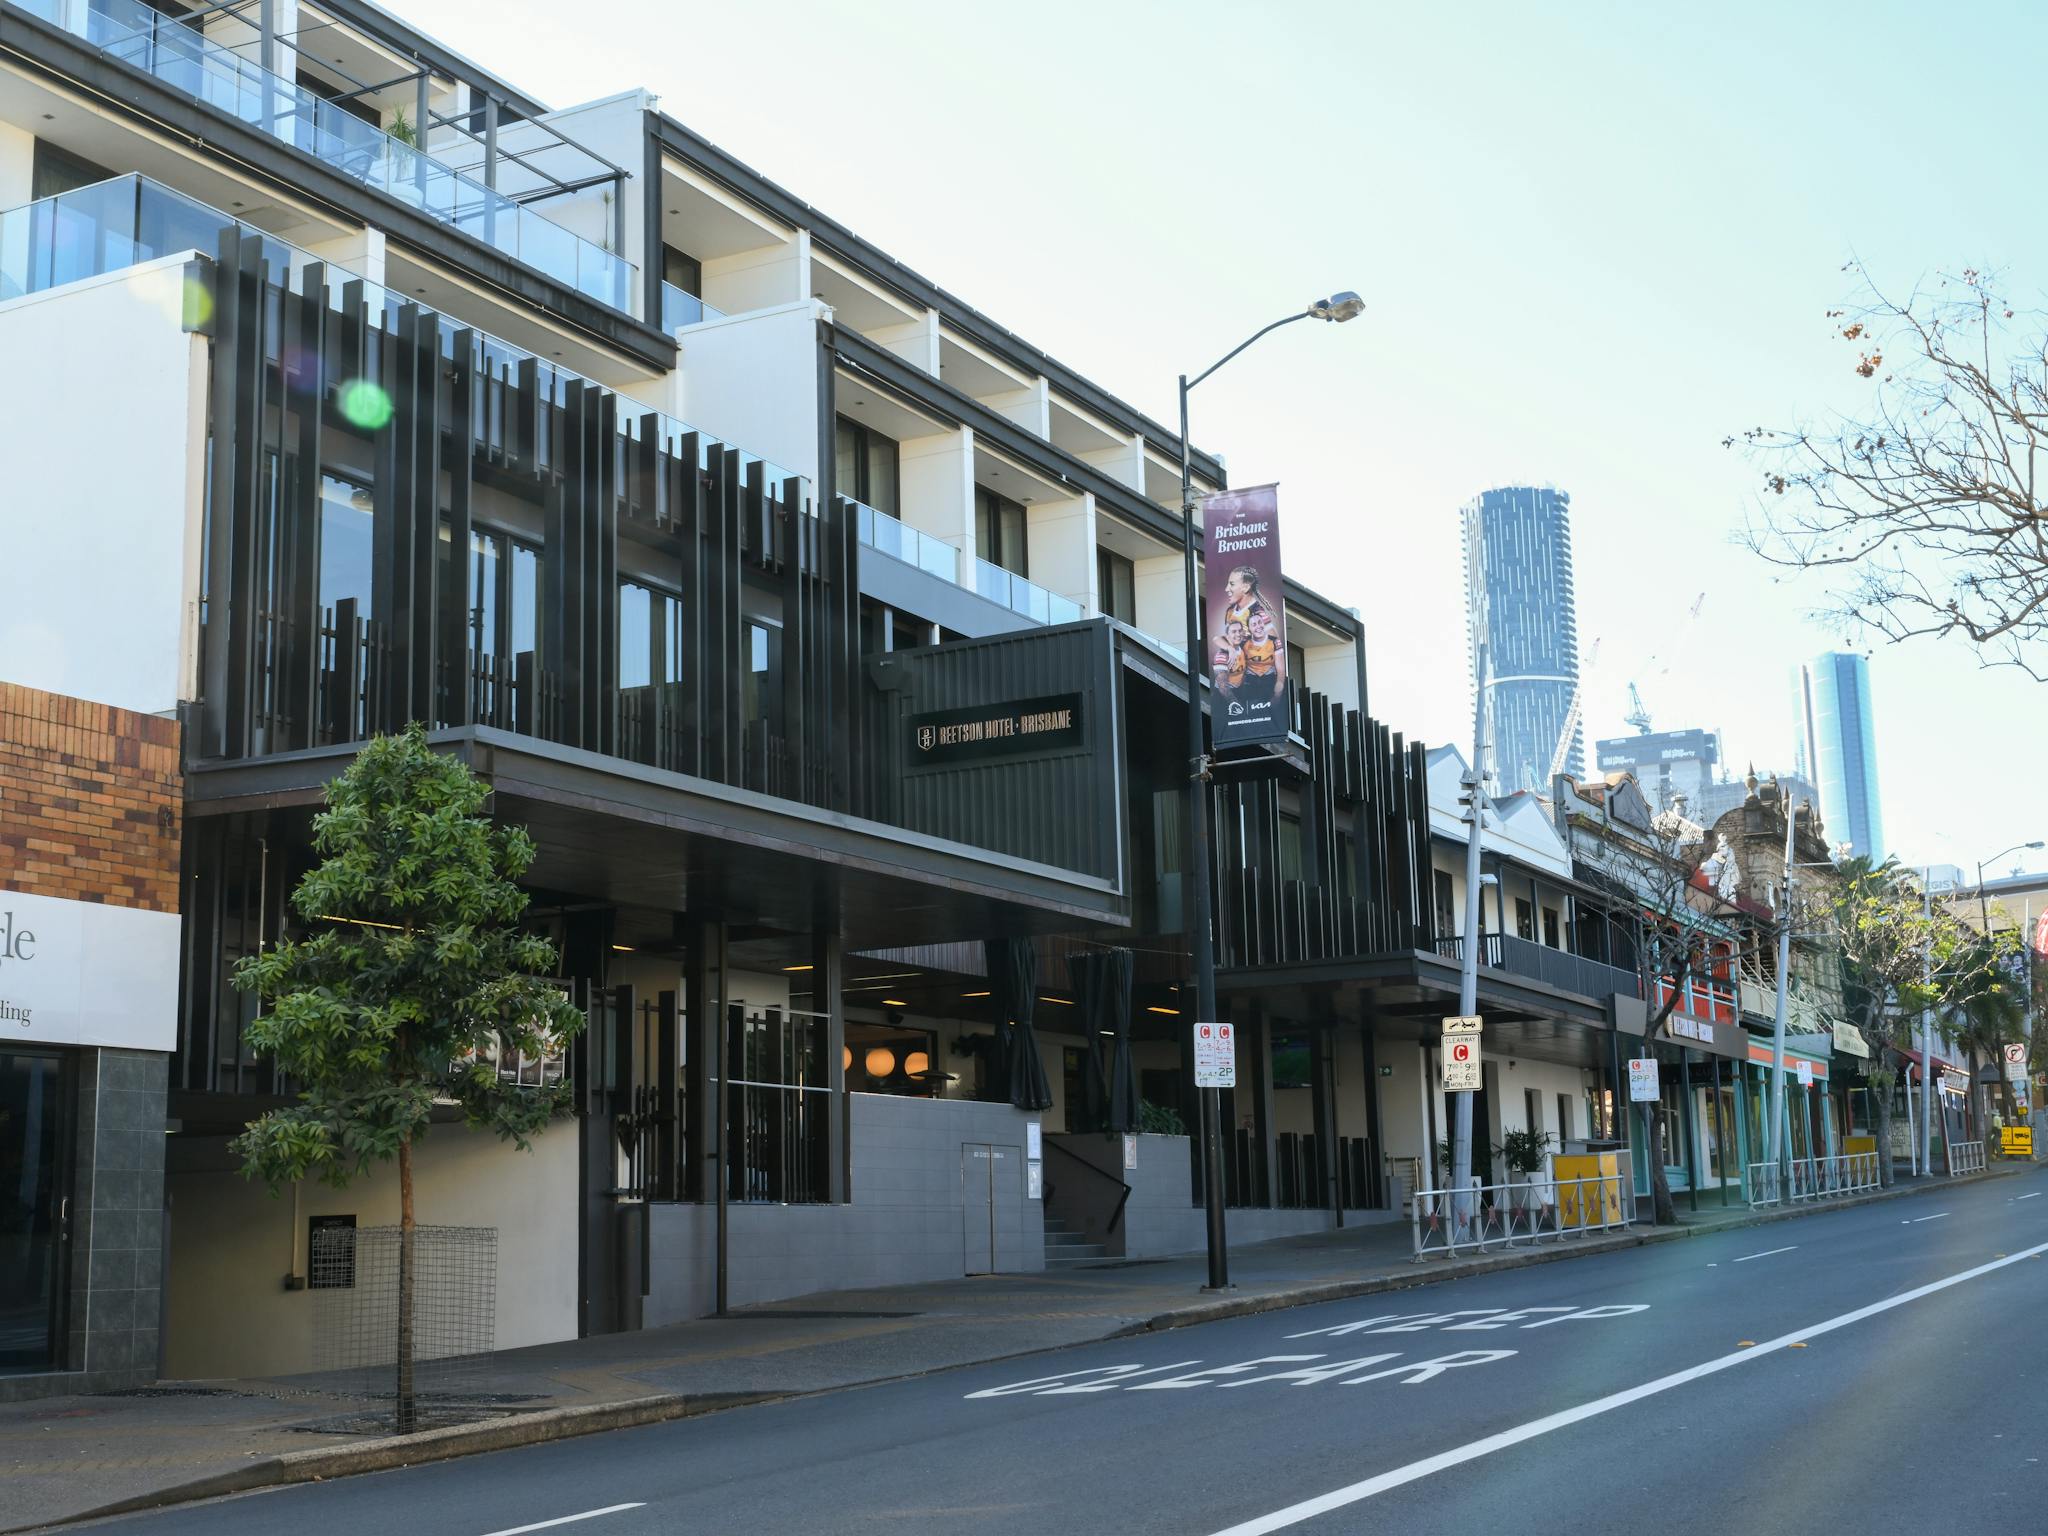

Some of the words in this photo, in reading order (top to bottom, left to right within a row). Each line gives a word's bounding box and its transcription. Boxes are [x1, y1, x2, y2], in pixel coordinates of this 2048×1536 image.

[1215, 521, 1268, 540] Brisbane
[1218, 536, 1267, 553] Broncos
[939, 722, 983, 745] BEETSON
[985, 717, 1015, 739] HOTEL
[1020, 709, 1072, 735] BRISBANE
[1200, 1025, 1210, 1039] C
[1220, 1025, 1230, 1039] C
[1446, 1036, 1475, 1044] CLEARWAY
[1455, 1046, 1467, 1060] C
[1219, 1067, 1233, 1077] 2P
[1284, 1304, 1651, 1338] KEEP
[963, 1349, 1519, 1399] CLEAR
